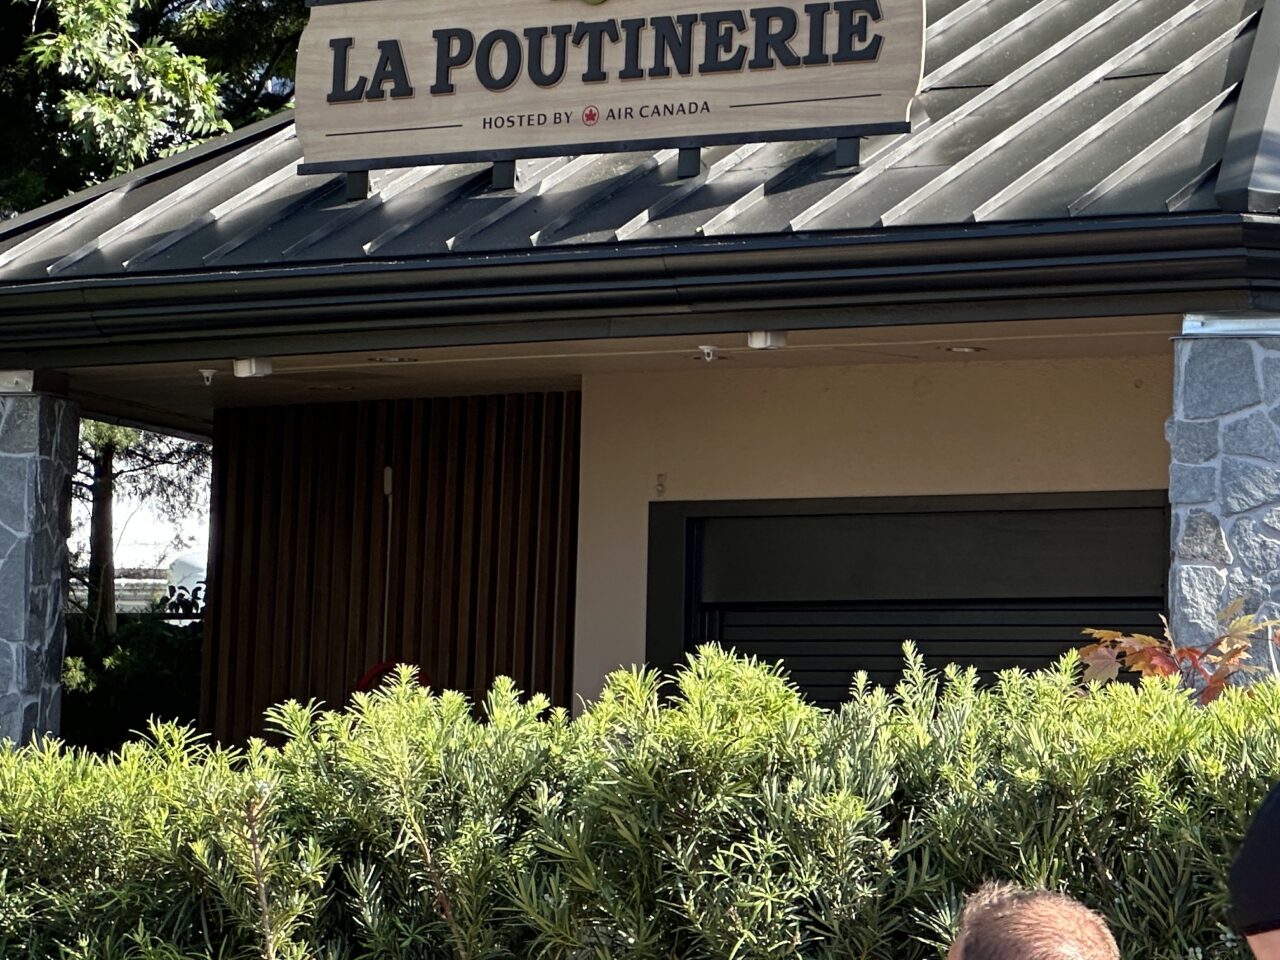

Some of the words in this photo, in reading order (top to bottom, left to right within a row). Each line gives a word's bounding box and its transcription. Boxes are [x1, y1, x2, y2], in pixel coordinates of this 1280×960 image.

[326, 37, 414, 103] LA
[482, 112, 547, 130] HOSTED
[552, 110, 573, 125] BY
[605, 106, 635, 121] AIR
[639, 100, 711, 119] CANADA
